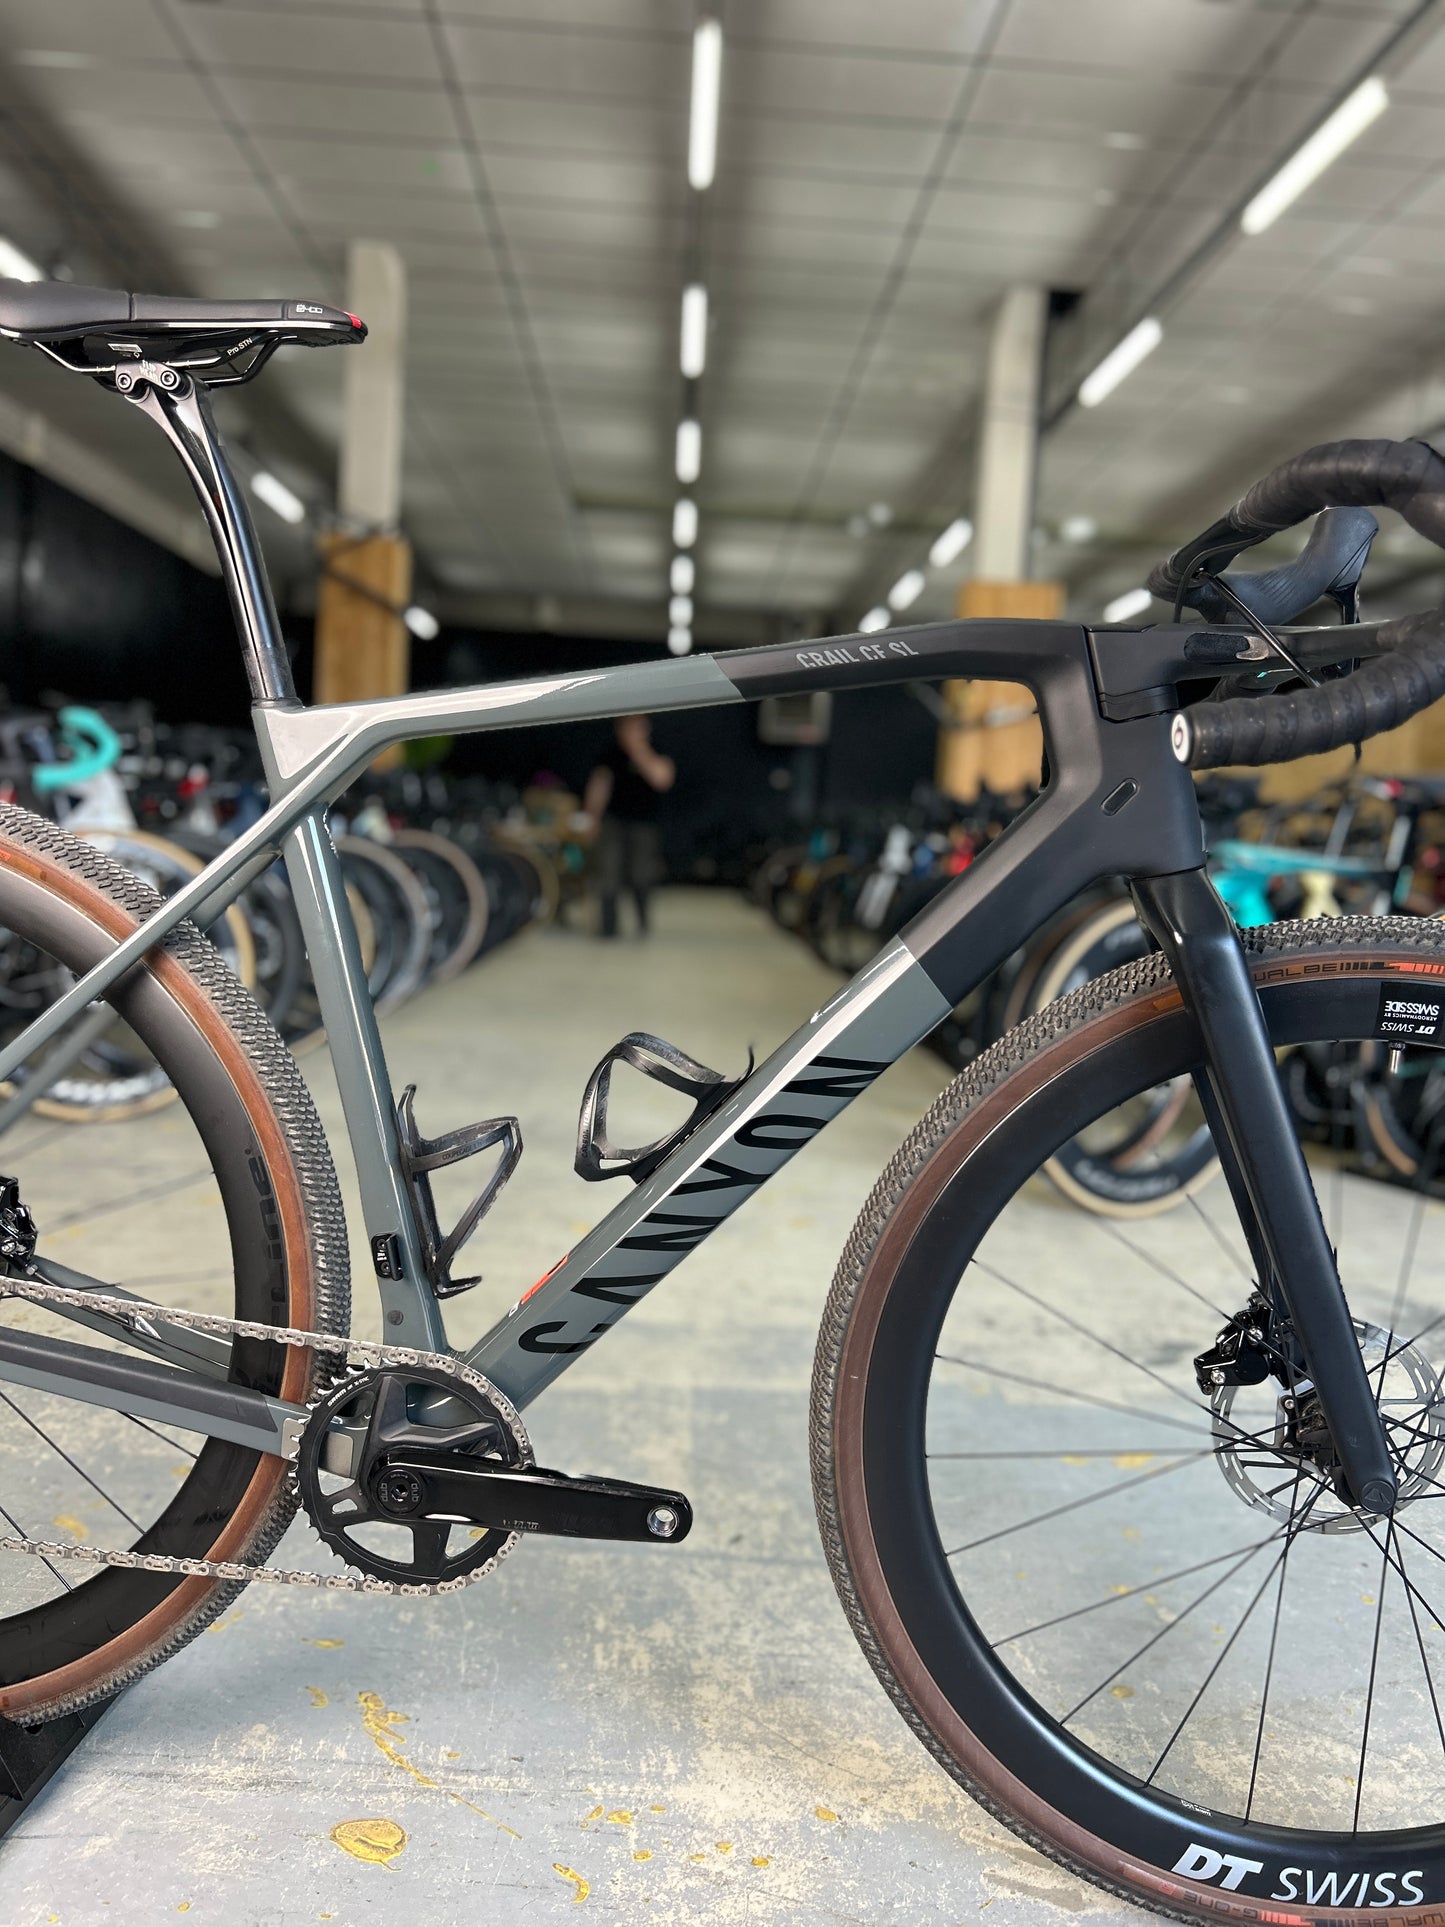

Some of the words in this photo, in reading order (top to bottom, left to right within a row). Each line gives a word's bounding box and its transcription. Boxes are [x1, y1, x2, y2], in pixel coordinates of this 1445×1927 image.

[238, 337, 253, 350] STN
[796, 648, 860, 668] GRAIL
[859, 644, 886, 661] CF
[888, 641, 919, 657] SL
[1380, 1021, 1415, 1033] SWISS
[1415, 1025, 1436, 1035] DT
[518, 1056, 894, 1354] CANYON
[1171, 1843, 1264, 1891] DT
[1270, 1867, 1425, 1908] SWISS
[1183, 1889, 1258, 1919] G-ONE
